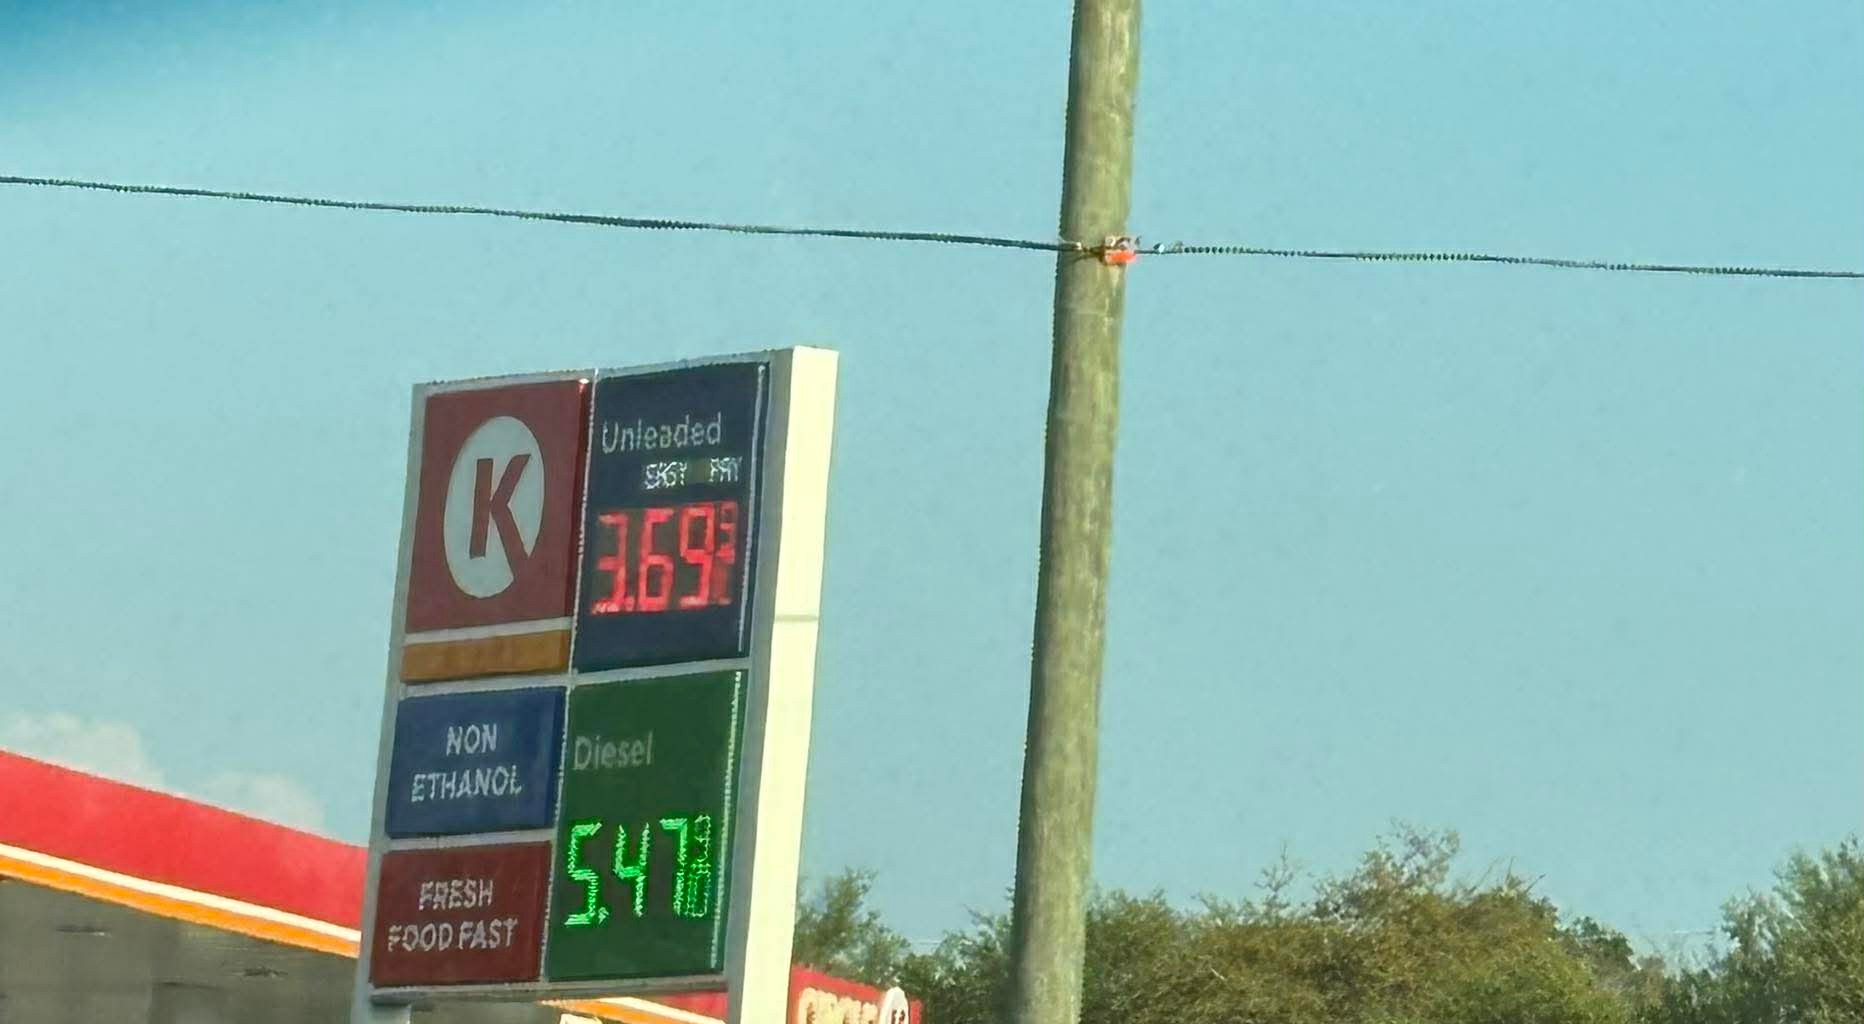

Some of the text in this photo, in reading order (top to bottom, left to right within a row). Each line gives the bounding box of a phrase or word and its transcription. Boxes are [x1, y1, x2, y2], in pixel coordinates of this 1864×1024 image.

[601, 411, 722, 454] Unleaded
[469, 453, 532, 588] K
[446, 723, 498, 756] NON
[574, 730, 653, 771] Diesel
[411, 764, 522, 803] ETHANOL
[418, 878, 494, 911] FRESH
[387, 917, 519, 952] FOOD FAST
